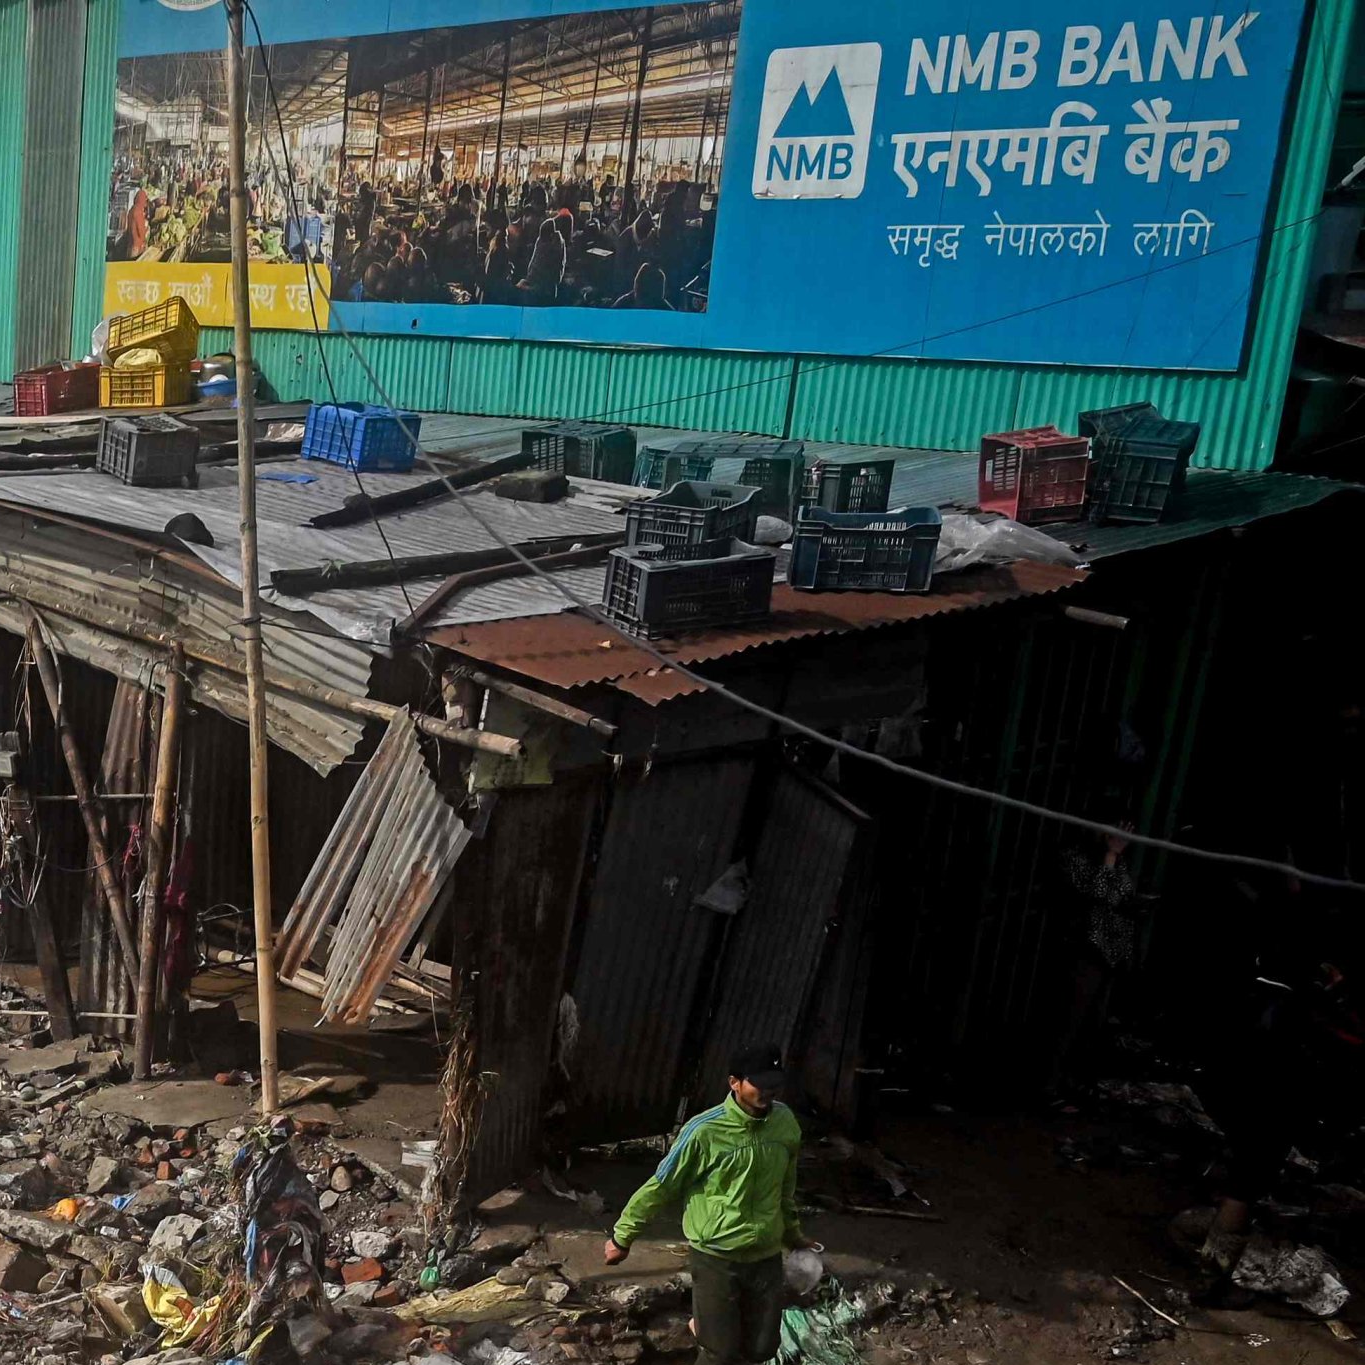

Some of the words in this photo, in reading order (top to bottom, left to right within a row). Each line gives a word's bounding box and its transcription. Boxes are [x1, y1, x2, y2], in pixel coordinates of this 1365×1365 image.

[904, 30, 1041, 95] NMB
[1057, 12, 1260, 87] BANK
[766, 143, 854, 181] NMB
[891, 101, 1110, 198] एनएमबि
[1124, 97, 1240, 183] बैंक
[886, 224, 965, 268] समृद्ध
[984, 210, 1111, 256] नेपालको
[1133, 209, 1215, 256] लागि
